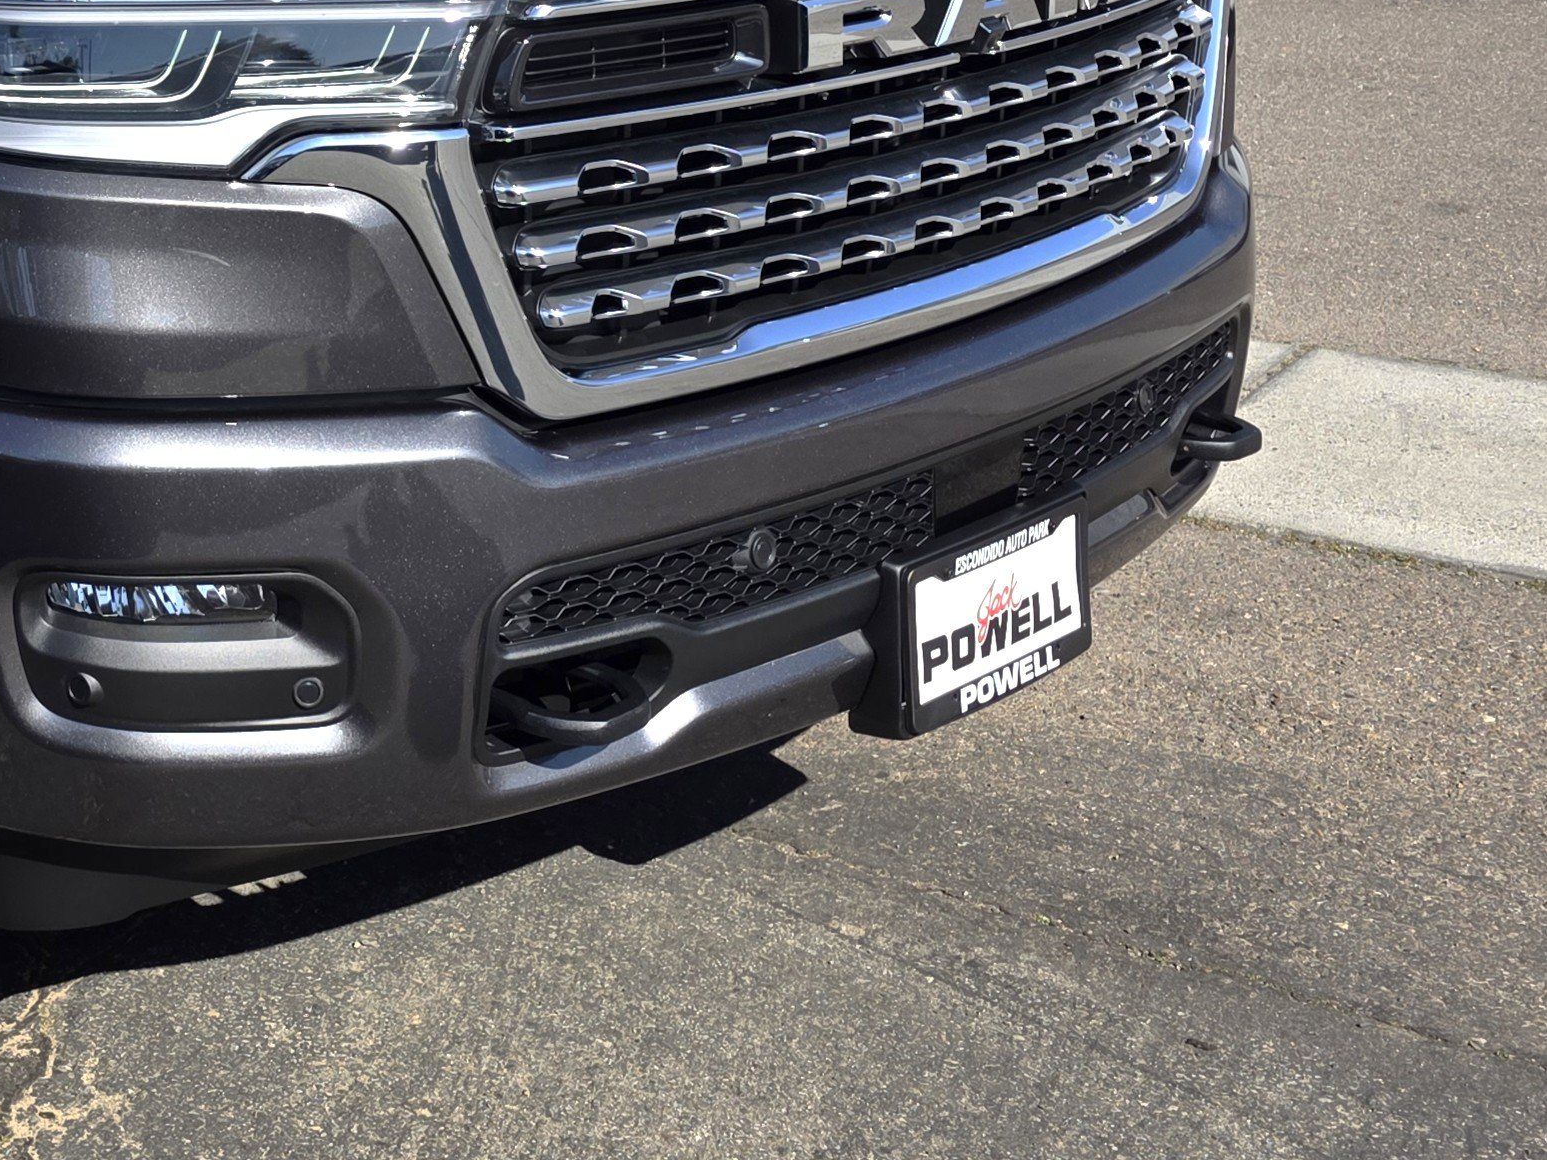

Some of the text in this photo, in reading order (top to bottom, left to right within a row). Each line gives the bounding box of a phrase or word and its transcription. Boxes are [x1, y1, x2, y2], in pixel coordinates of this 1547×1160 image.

[954, 518, 1051, 576] ESCONDIDO AUTO PARK
[921, 580, 1073, 684] POWELL
[977, 571, 1023, 643] Jack
[960, 645, 1061, 714] POWELL
